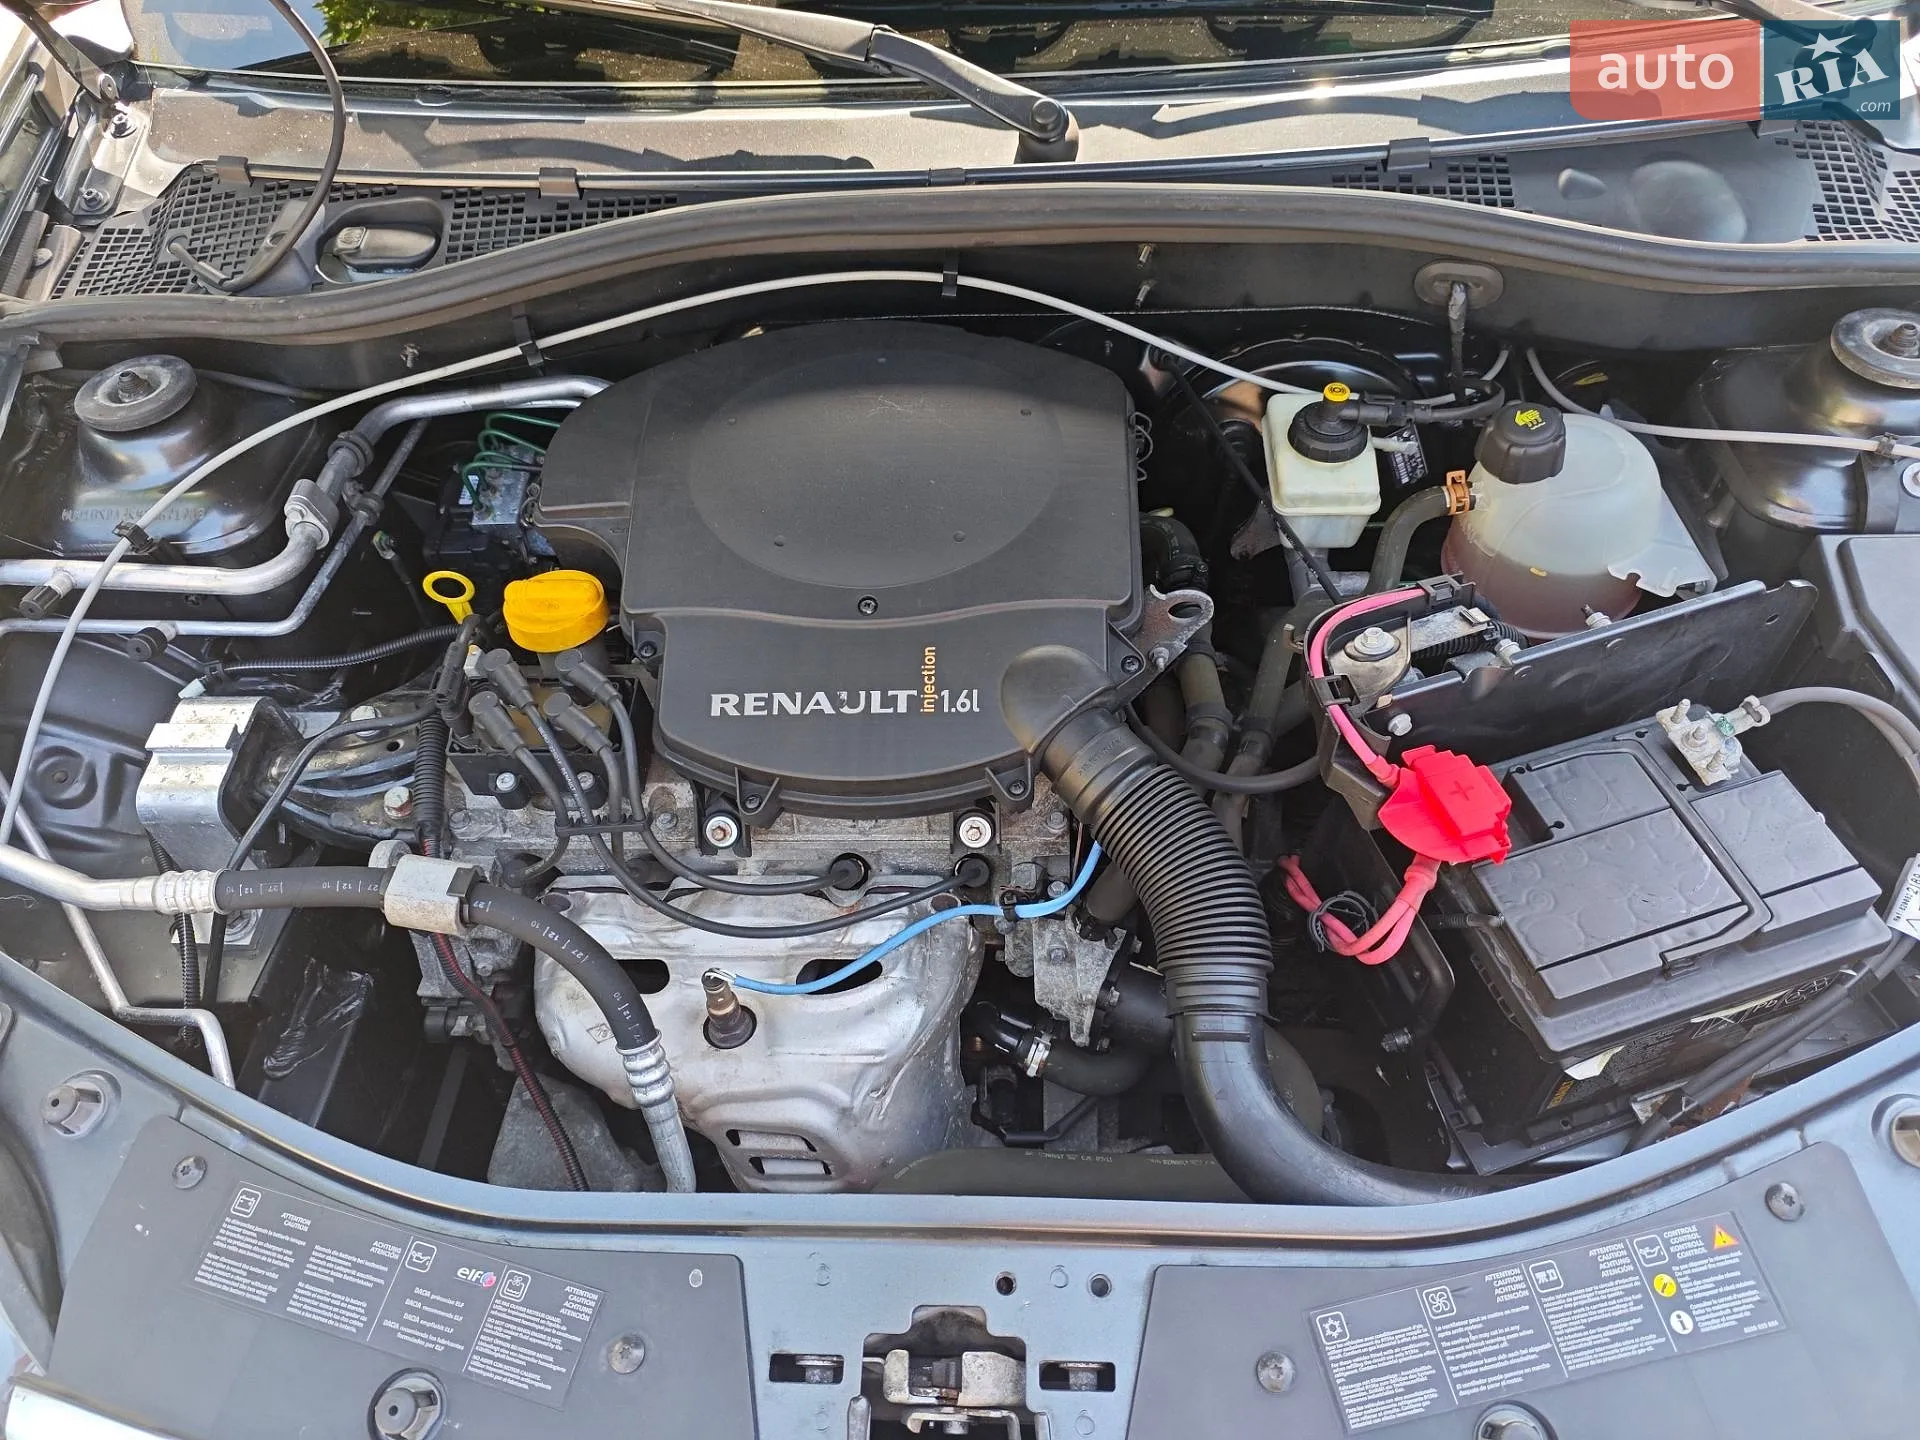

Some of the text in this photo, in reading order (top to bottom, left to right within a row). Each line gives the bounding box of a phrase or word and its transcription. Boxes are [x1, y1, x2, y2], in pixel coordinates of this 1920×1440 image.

[920, 646, 936, 712] injection
[710, 690, 979, 716] RENAULT 1.6l
[281, 1213, 311, 1225] ATTENTION
[284, 1220, 308, 1231] CAUTION
[1670, 1233, 1700, 1244] CONTROL
[373, 1241, 401, 1253] ACHTUNG
[1589, 1243, 1624, 1256] ATTENTION
[1670, 1240, 1704, 1252] KONTROLL
[1598, 1250, 1626, 1261] CAUTION
[1677, 1247, 1707, 1259] CONTROL
[1600, 1257, 1630, 1269] ACHTUNG
[457, 1268, 483, 1281] elf
[1485, 1268, 1520, 1281] ATTENTION
[1494, 1275, 1523, 1286] CAUTION
[565, 1286, 598, 1300] ATTENTION
[1495, 1283, 1526, 1294] ACHTUNG
[569, 1295, 595, 1307] CAUTION
[564, 1301, 592, 1314] ACHTUNG
